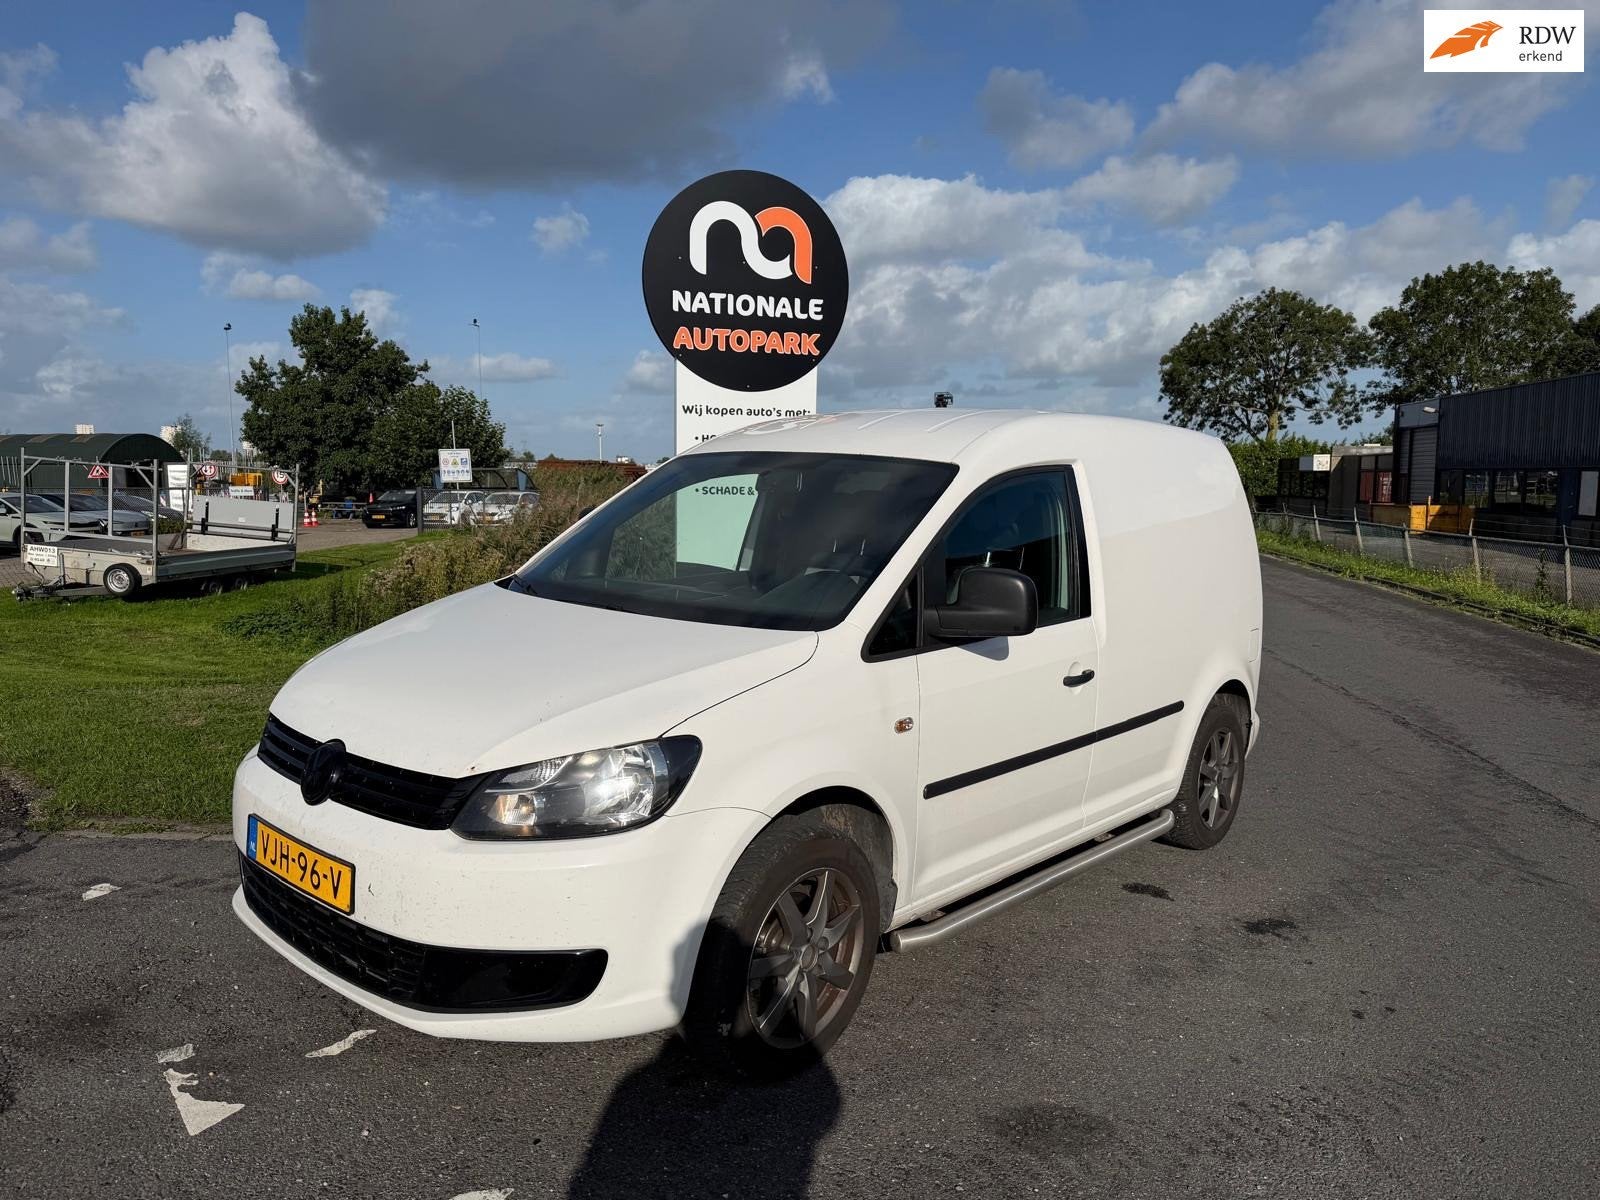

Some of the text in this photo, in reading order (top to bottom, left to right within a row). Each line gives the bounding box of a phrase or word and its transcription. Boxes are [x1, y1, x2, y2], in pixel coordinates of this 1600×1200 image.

[672, 289, 824, 321] NATIONALE
[673, 326, 821, 356] AUTOPARK
[682, 404, 703, 417] Wij
[705, 404, 743, 417] kopen
[746, 407, 782, 417] auto's
[702, 486, 755, 496] SCHADE &
[261, 829, 342, 900] VJH-96-V
